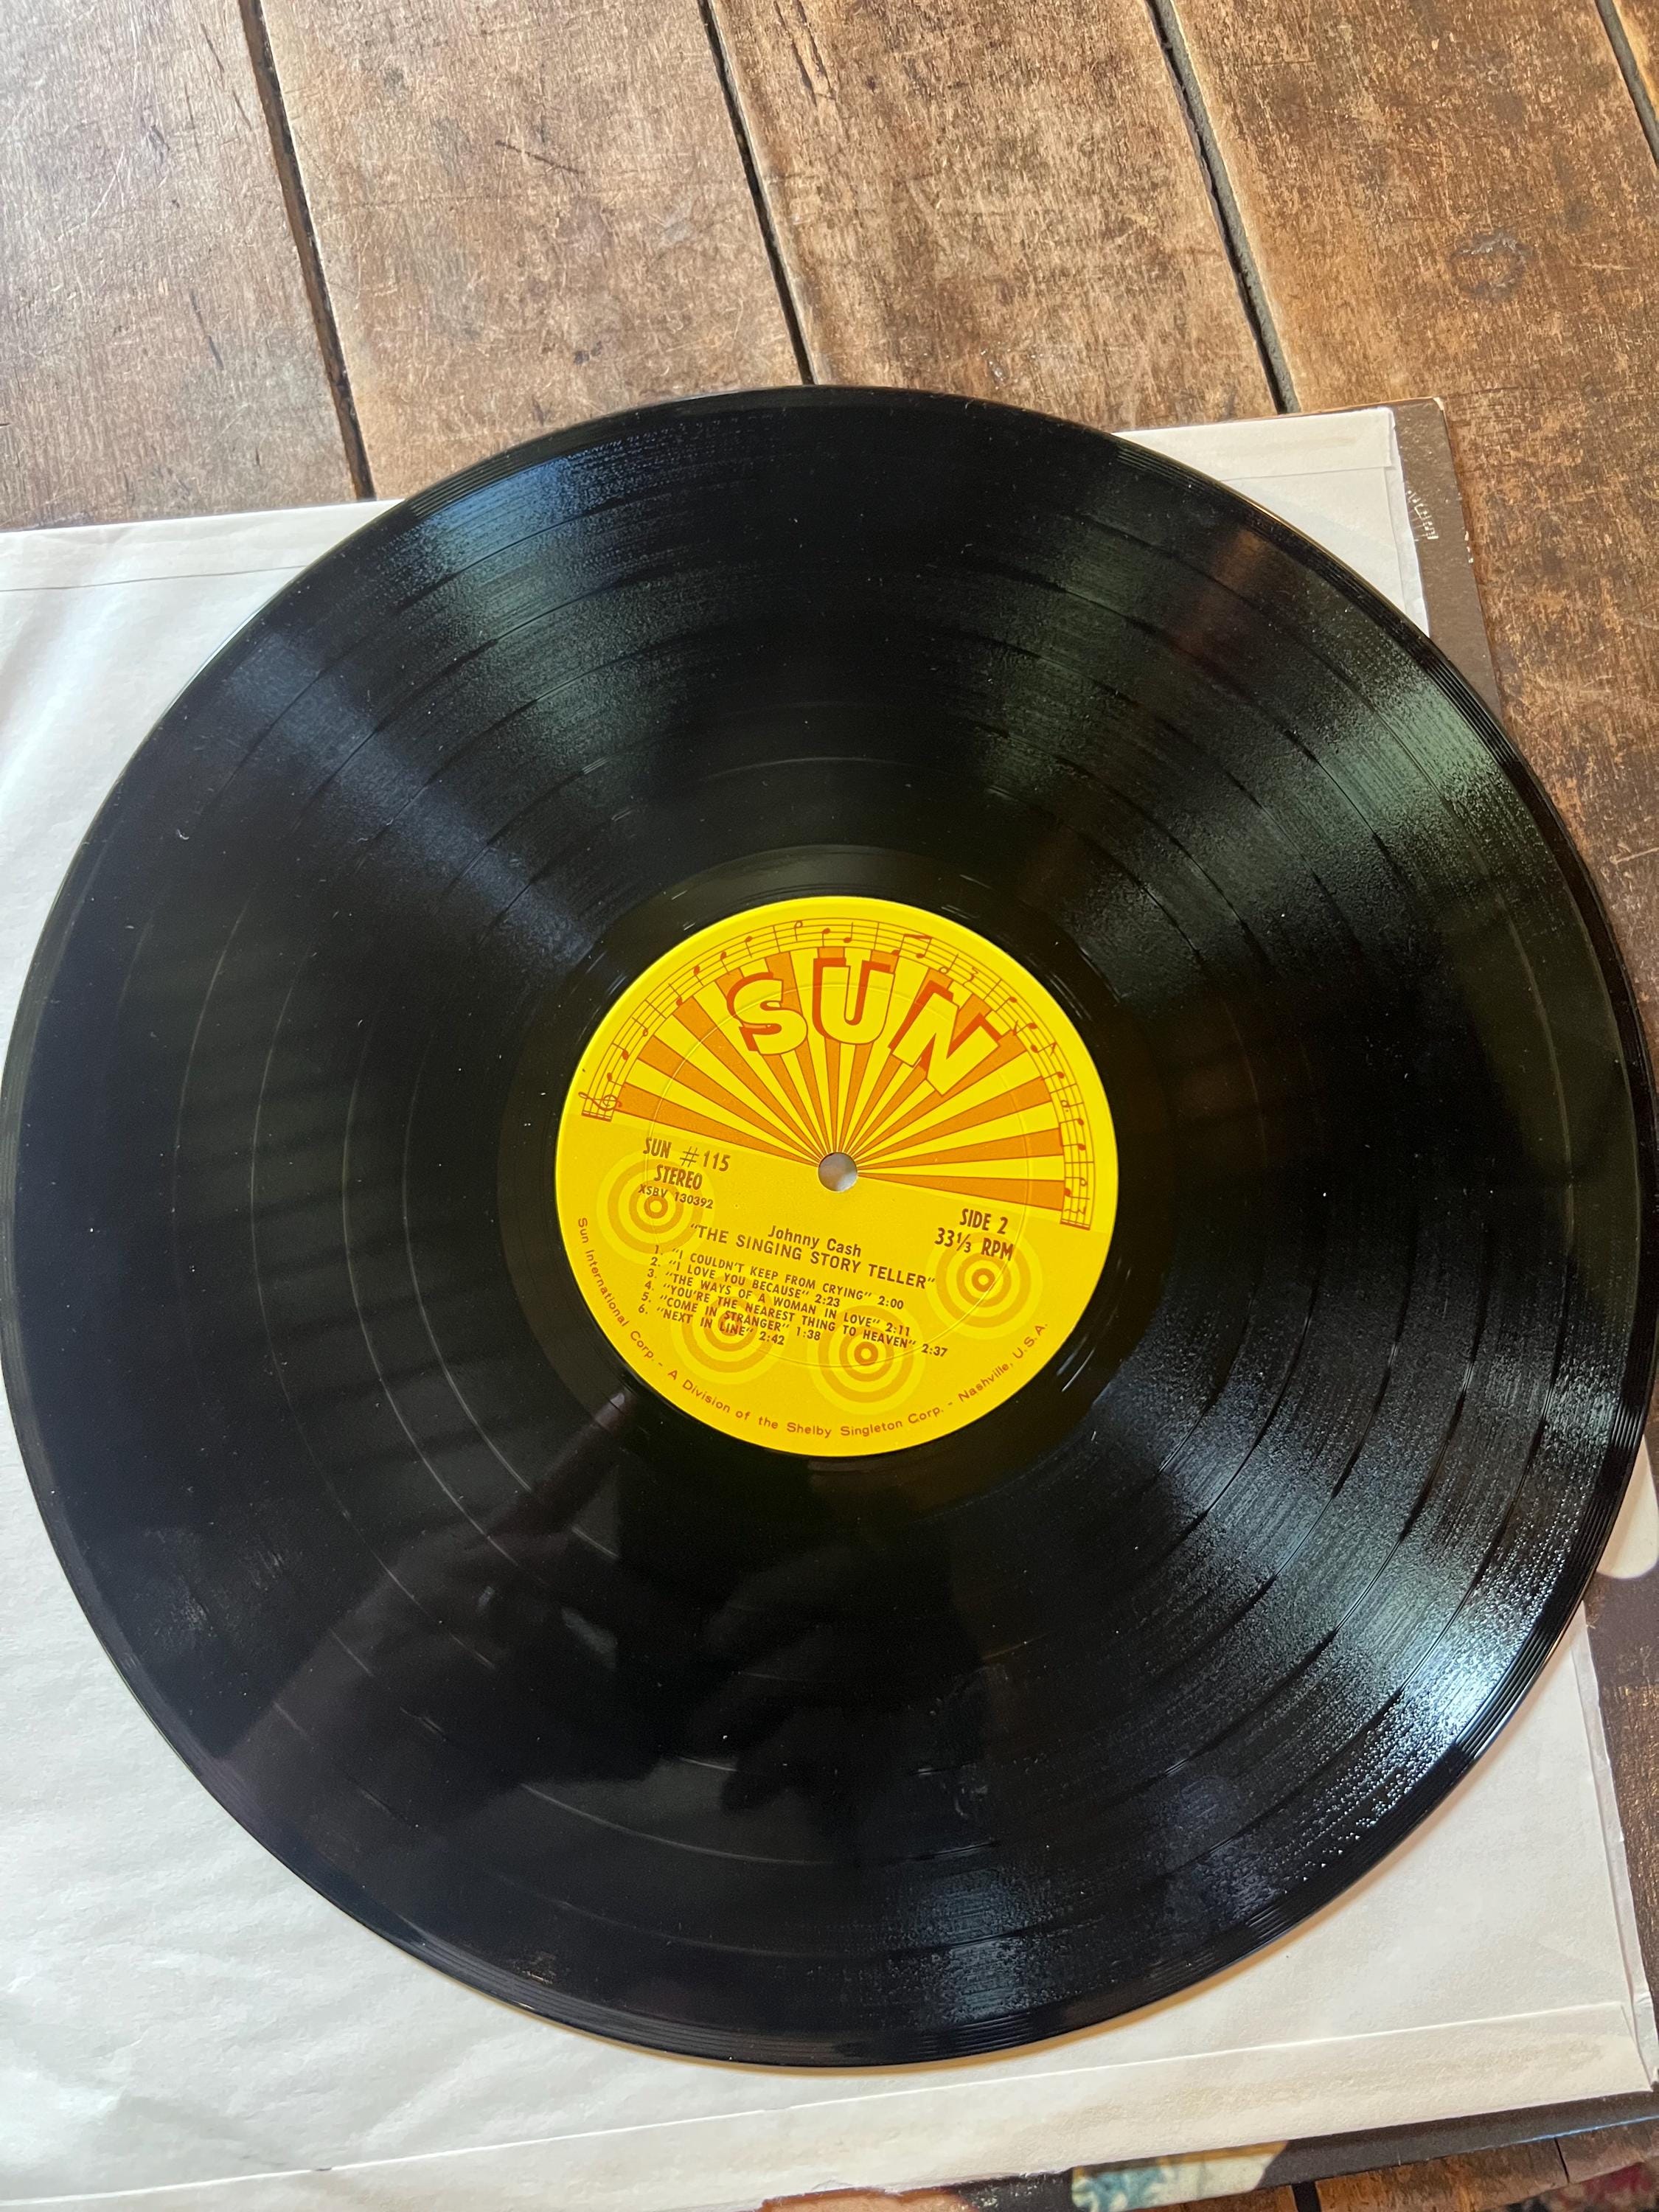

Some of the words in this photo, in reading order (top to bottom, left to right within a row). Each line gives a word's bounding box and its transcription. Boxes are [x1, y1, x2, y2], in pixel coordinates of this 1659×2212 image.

[726, 958, 1001, 1096] SUN
[643, 1137, 672, 1158] SUN
[680, 1146, 731, 1172] #115
[639, 1183, 667, 1198] XSBV
[674, 1192, 714, 1209] 130392
[654, 1164, 703, 1190] STEREO
[768, 1225, 820, 1251] Johnny
[827, 1238, 861, 1257] Cash
[959, 1208, 992, 1231] SIDE
[997, 1217, 1008, 1234] 2
[736, 1234, 802, 1261] SINGING
[810, 1251, 861, 1273] STORY
[981, 1237, 1014, 1261] RPM
[650, 1256, 661, 1267] 2.
[687, 1265, 716, 1279] LOVE
[724, 1273, 745, 1286] YOU
[814, 1294, 840, 1307] 2:23
[654, 1245, 663, 1256] 1.
[690, 1253, 745, 1273] COULDN'T
[750, 1265, 779, 1280] KEEP
[785, 1274, 815, 1290] FROM
[877, 1295, 904, 1310] 2:00
[641, 1292, 651, 1302] 5.
[705, 1306, 717, 1317] IN
[796, 1326, 821, 1340] 1:38
[644, 1280, 654, 1291] 4.
[717, 1296, 737, 1310] THE
[745, 1303, 795, 1322] NEAREST
[801, 1315, 836, 1332] THING
[843, 1324, 856, 1337] TO
[922, 1343, 948, 1357] 2:37
[647, 1268, 657, 1279] 3.
[700, 1280, 731, 1295] WAYS
[738, 1288, 752, 1300] OF
[758, 1293, 766, 1303] A
[773, 1297, 816, 1315] WOMAN
[824, 1308, 838, 1319] IN
[886, 1323, 911, 1336] 2:11
[578, 1217, 589, 1244] Sun
[585, 1249, 630, 1327] International
[630, 1330, 655, 1361] Corp.
[667, 1370, 678, 1380] A
[682, 1380, 731, 1413] Division
[735, 1411, 751, 1420] of
[758, 1416, 779, 1429] the
[787, 1422, 832, 1438] Shelby
[840, 1419, 903, 1437] Singleton
[908, 1406, 944, 1425] Corp.
[958, 1362, 1014, 1402] Nashville,
[638, 1304, 648, 1314] 6.
[700, 1317, 713, 1328] IN
[759, 1331, 785, 1345] 2:42
